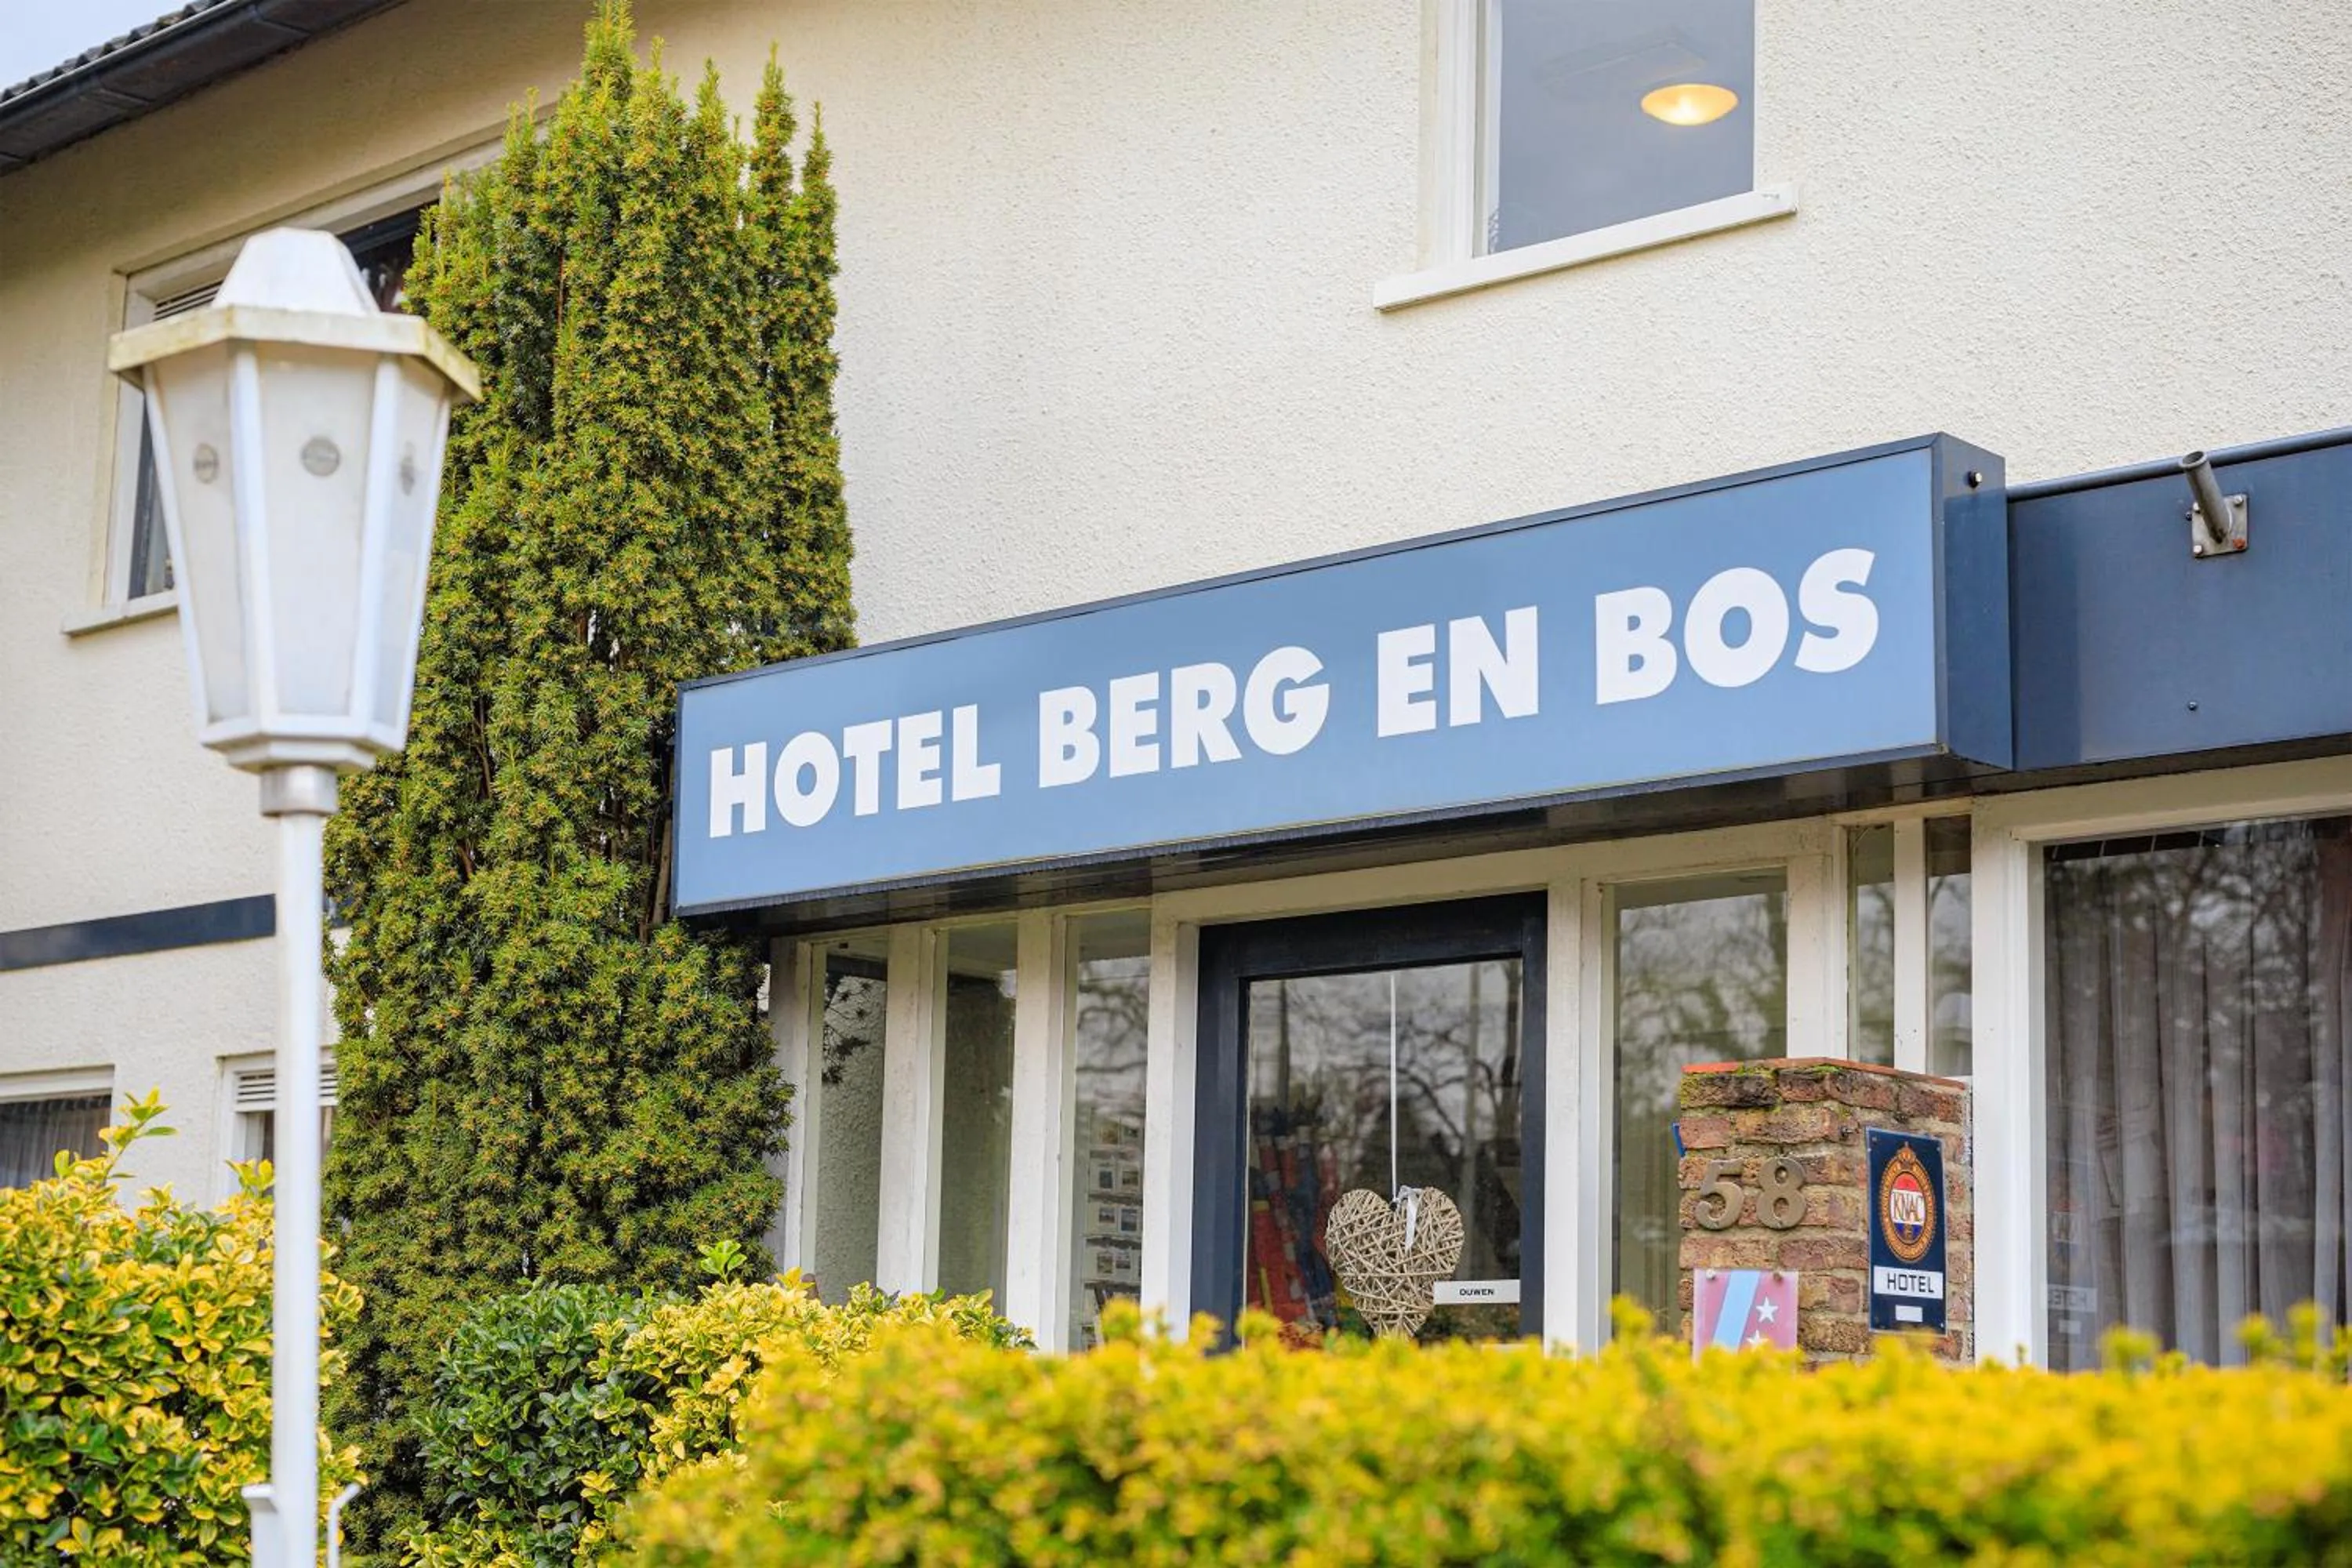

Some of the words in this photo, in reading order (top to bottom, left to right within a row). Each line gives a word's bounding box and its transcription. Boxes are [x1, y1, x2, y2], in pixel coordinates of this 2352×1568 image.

[710, 704, 1000, 838] HOTEL
[1039, 646, 1330, 788] BERG
[1377, 605, 1538, 738] EN
[1595, 548, 1879, 705] BOS
[1694, 1156, 1805, 1230] 58
[1887, 1272, 1934, 1294] HOTEL
